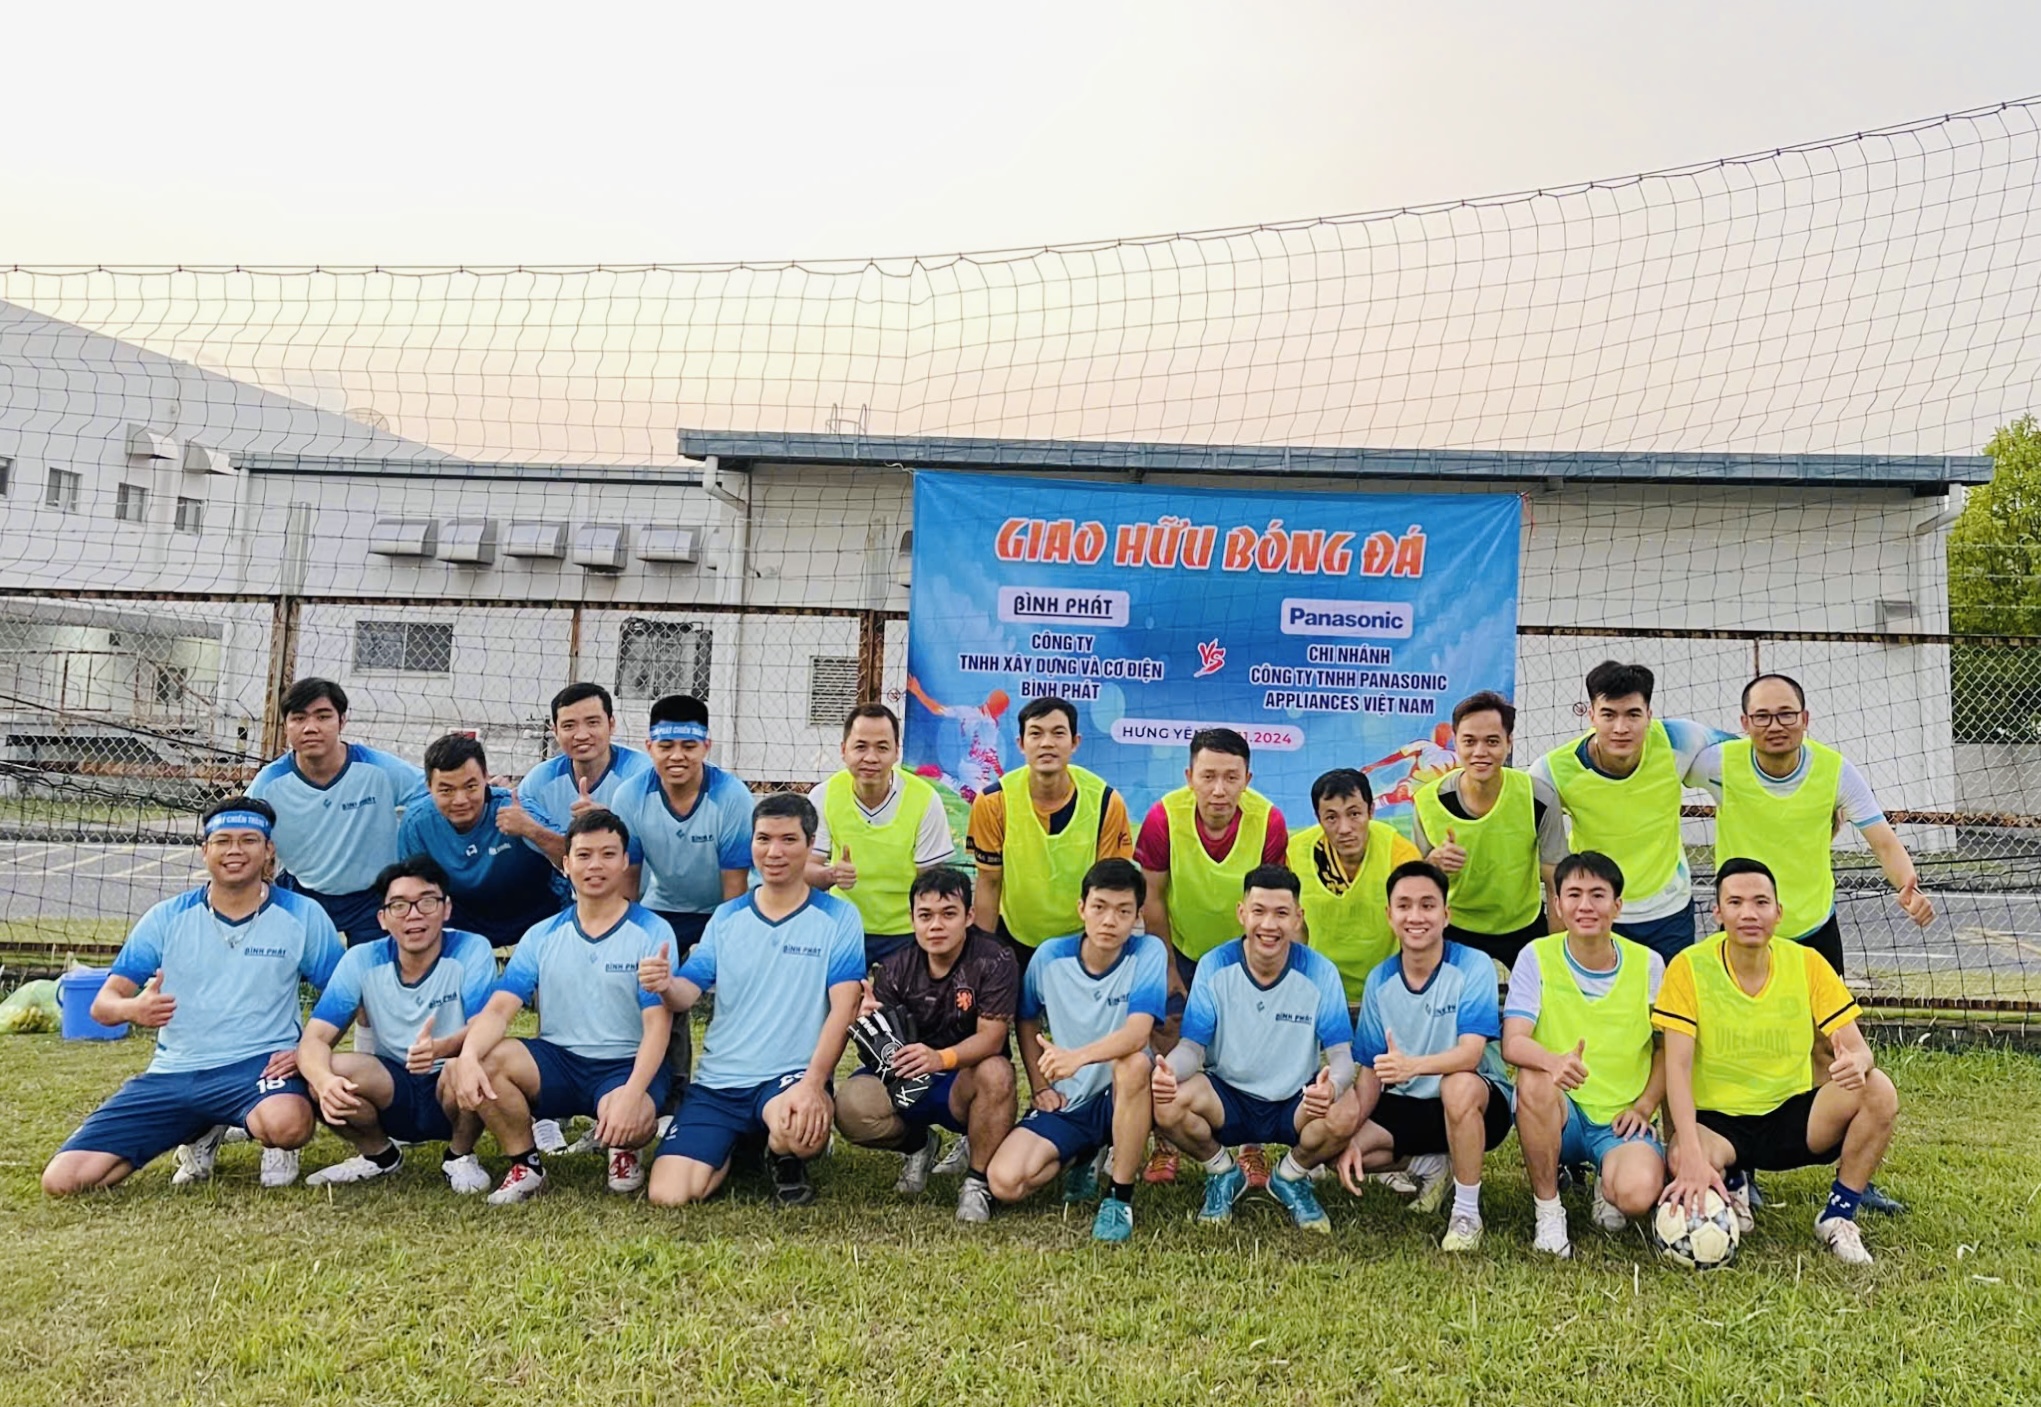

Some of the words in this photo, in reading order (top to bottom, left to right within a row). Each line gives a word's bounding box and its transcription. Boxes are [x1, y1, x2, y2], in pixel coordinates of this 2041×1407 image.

[995, 517, 1107, 565] GIAO
[1113, 515, 1218, 569] HỮU
[1222, 519, 1355, 576] BÓNG
[1360, 524, 1427, 578] ĐÁ
[1013, 592, 1058, 615] BÌNH
[1066, 594, 1113, 617] PHÁT
[1289, 607, 1404, 630] Panasonic
[1031, 631, 1073, 651] CÔNG
[1075, 634, 1095, 652] TY
[1195, 639, 1226, 677] VS
[1308, 645, 1334, 663] CHI
[1337, 643, 1391, 665] NHÁNH
[959, 654, 1000, 672] TNHH
[1002, 653, 1033, 674] XÂY
[1036, 657, 1078, 679] DỰNG
[1080, 655, 1100, 676] VÀ
[1103, 660, 1124, 677] CƠ
[1126, 659, 1164, 683] ĐIỆN
[1250, 663, 1292, 685] CÔNG
[1294, 668, 1314, 686] TY
[1316, 670, 1356, 687] TNHH
[1359, 672, 1448, 691] PANASONIC
[1021, 677, 1057, 698] BÌNH
[1061, 679, 1101, 700] PHÁT
[1265, 692, 1360, 712] APPLIANCES
[1363, 693, 1395, 716] VIỆT
[1398, 697, 1435, 714] NAM
[1122, 726, 1170, 740] HƯNG
